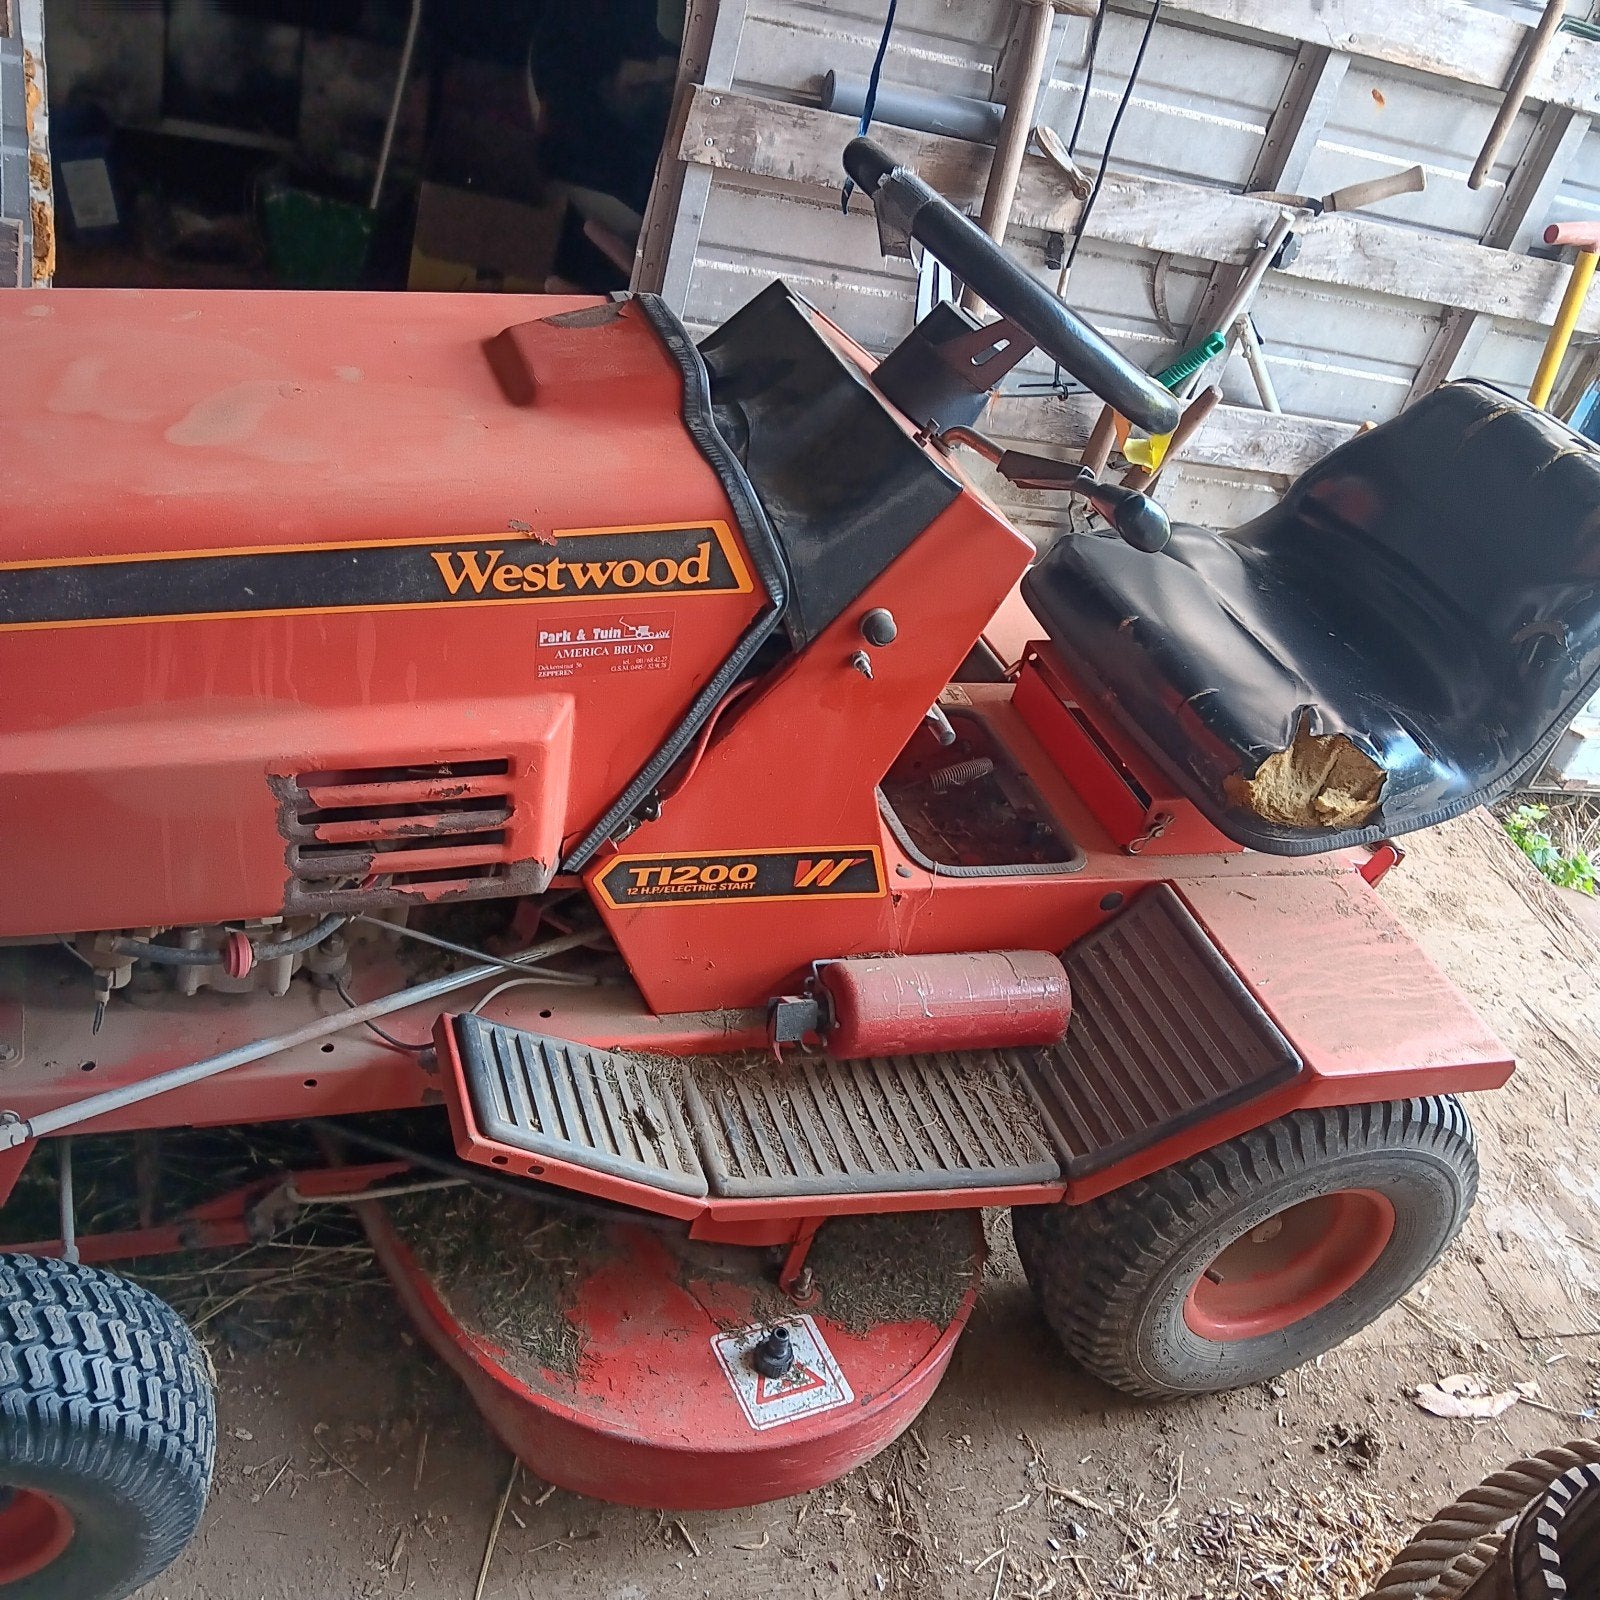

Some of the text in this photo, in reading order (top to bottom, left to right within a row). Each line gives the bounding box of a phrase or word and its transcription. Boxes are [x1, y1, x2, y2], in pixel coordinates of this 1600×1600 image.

[431, 541, 711, 595] Westwood
[539, 626, 622, 644] Park & Tuin
[554, 644, 654, 659] AMERICA BRUNO
[626, 888, 639, 896] 12
[718, 881, 757, 891] START
